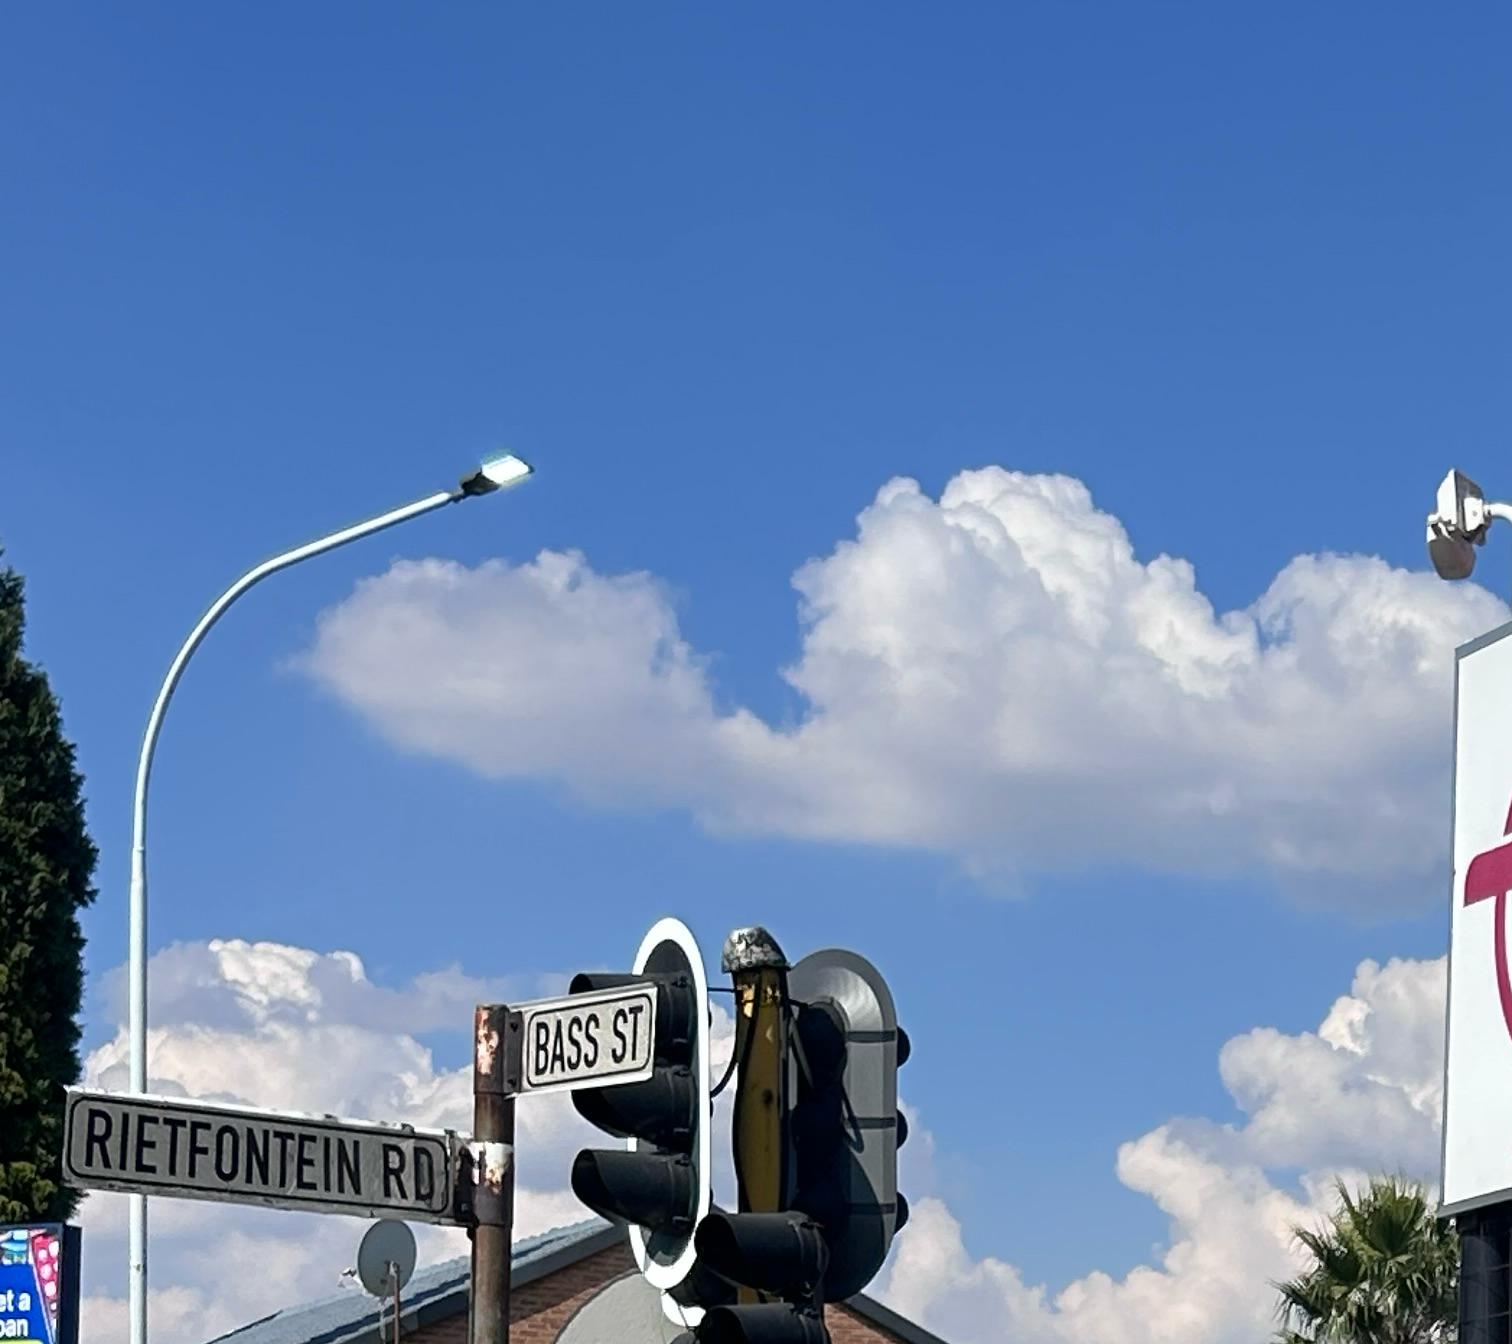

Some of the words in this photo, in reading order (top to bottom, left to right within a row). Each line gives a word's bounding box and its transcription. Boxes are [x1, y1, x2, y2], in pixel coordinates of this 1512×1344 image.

[534, 1011, 600, 1077] BASS
[611, 1004, 644, 1064] ST
[83, 1107, 363, 1197] RIETFONTEIN
[382, 1143, 434, 1203] RD
[18, 1292, 31, 1312] a
